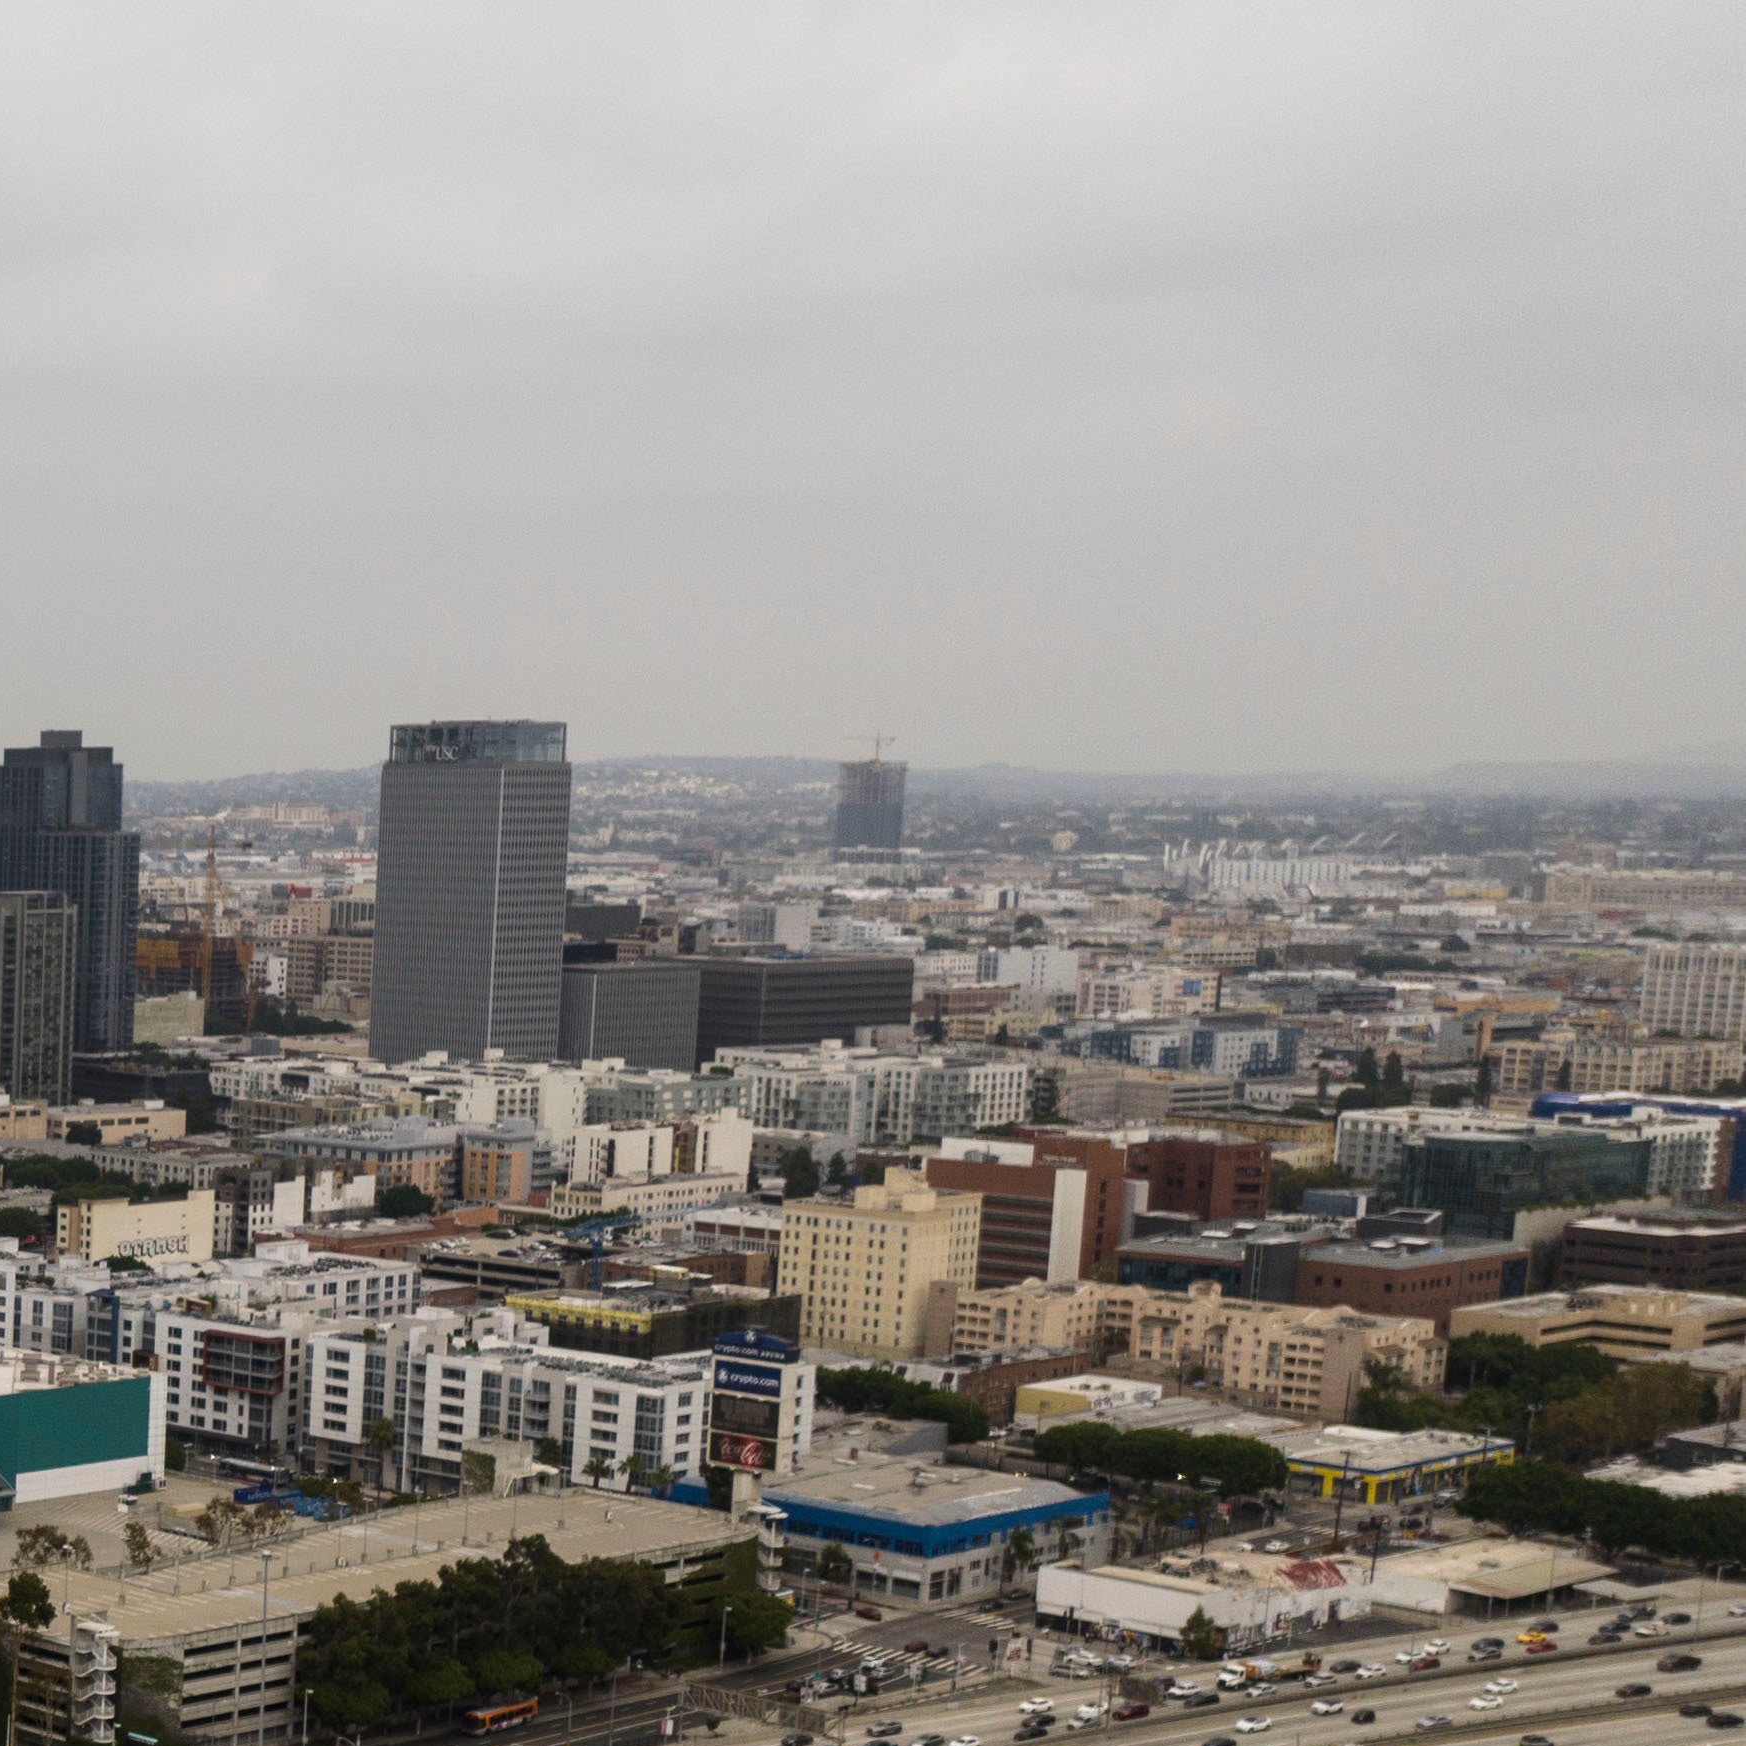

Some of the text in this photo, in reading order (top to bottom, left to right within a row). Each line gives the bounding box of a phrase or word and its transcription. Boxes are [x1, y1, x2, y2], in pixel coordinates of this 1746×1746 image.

[436, 745, 459, 761] USC
[760, 1350, 786, 1361] ARENA
[730, 1373, 780, 1388] crypto.com
